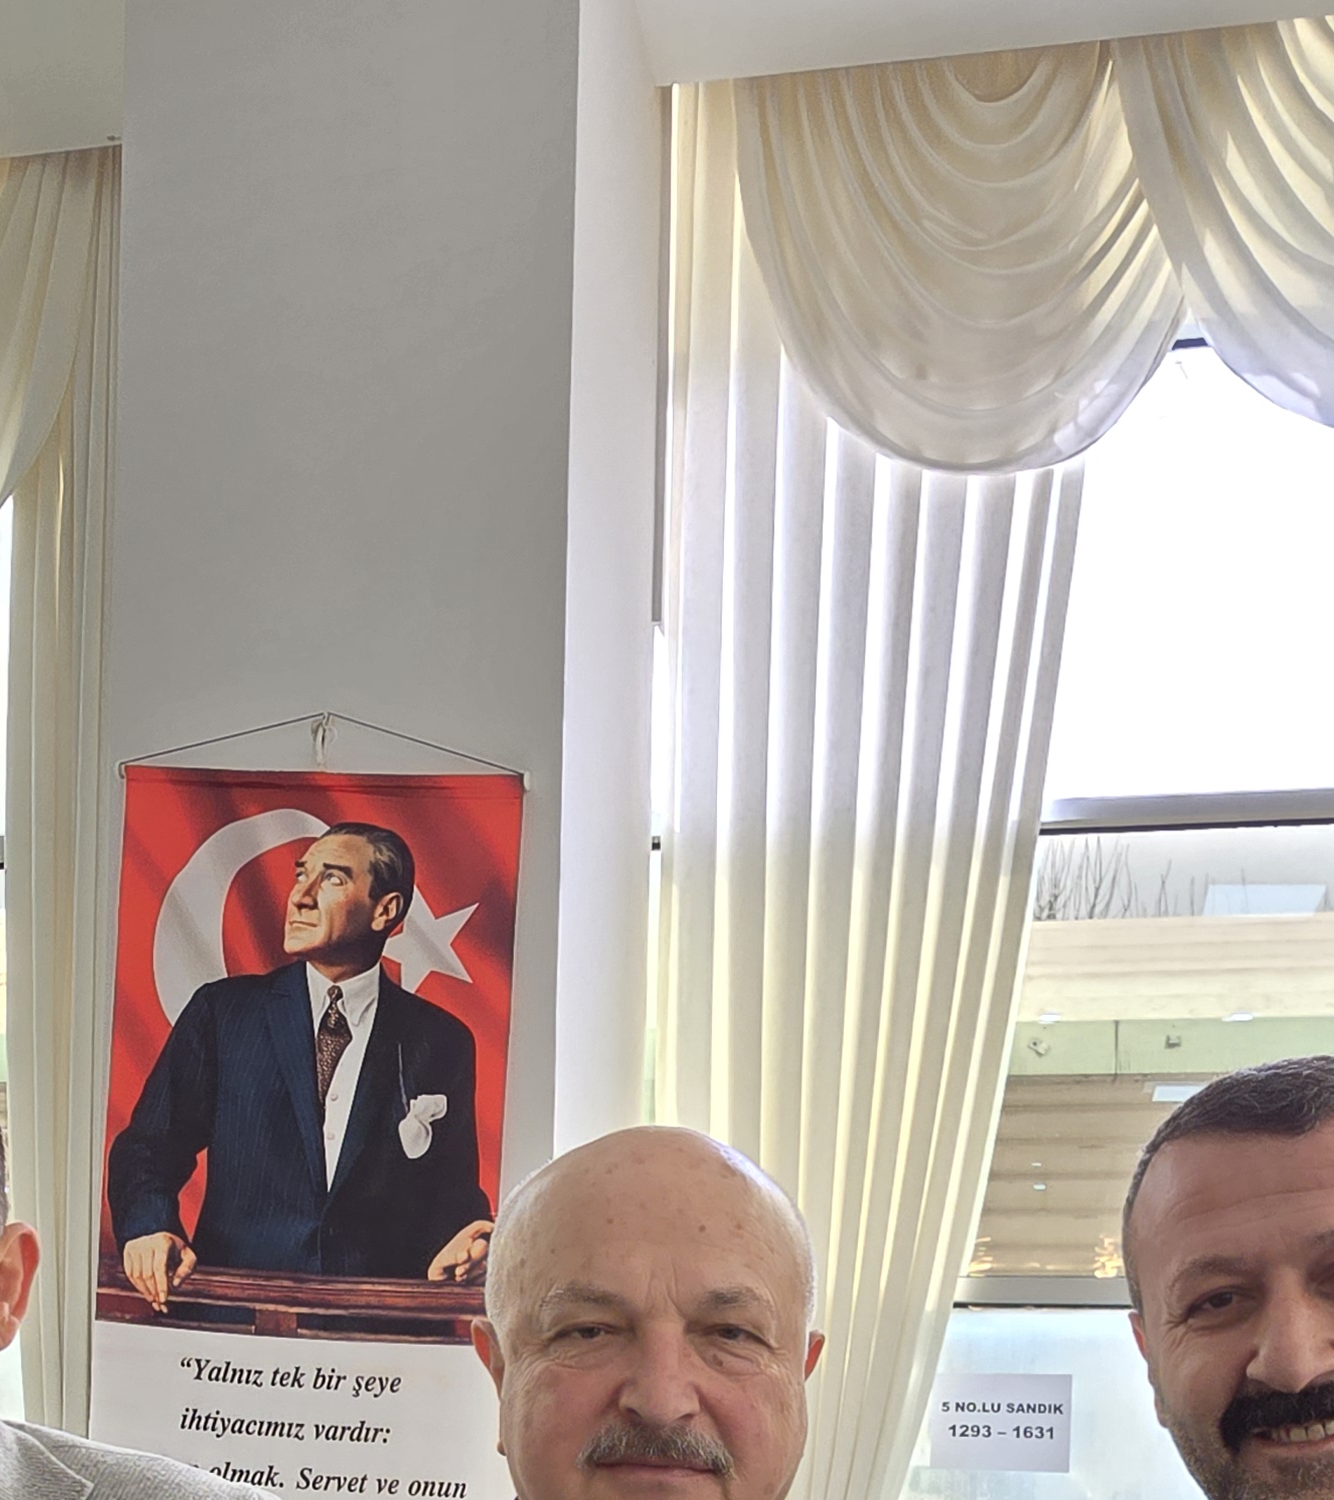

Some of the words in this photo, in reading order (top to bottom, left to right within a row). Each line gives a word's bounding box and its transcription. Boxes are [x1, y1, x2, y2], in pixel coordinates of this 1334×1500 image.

[270, 1366, 306, 1389] tek
[312, 1367, 347, 1391] bir
[352, 1374, 402, 1398] şeye
[941, 1402, 950, 1413] 5
[955, 1402, 1001, 1414] NO.LU
[1006, 1403, 1064, 1415] SANDIK
[180, 1407, 305, 1441] ihtiyacımız
[313, 1420, 391, 1444] vardır:
[948, 1424, 992, 1438] 1293
[1012, 1425, 1055, 1440] 1631
[296, 1467, 368, 1494] Servet
[376, 1477, 400, 1495] ve
[408, 1479, 467, 1499] onun
